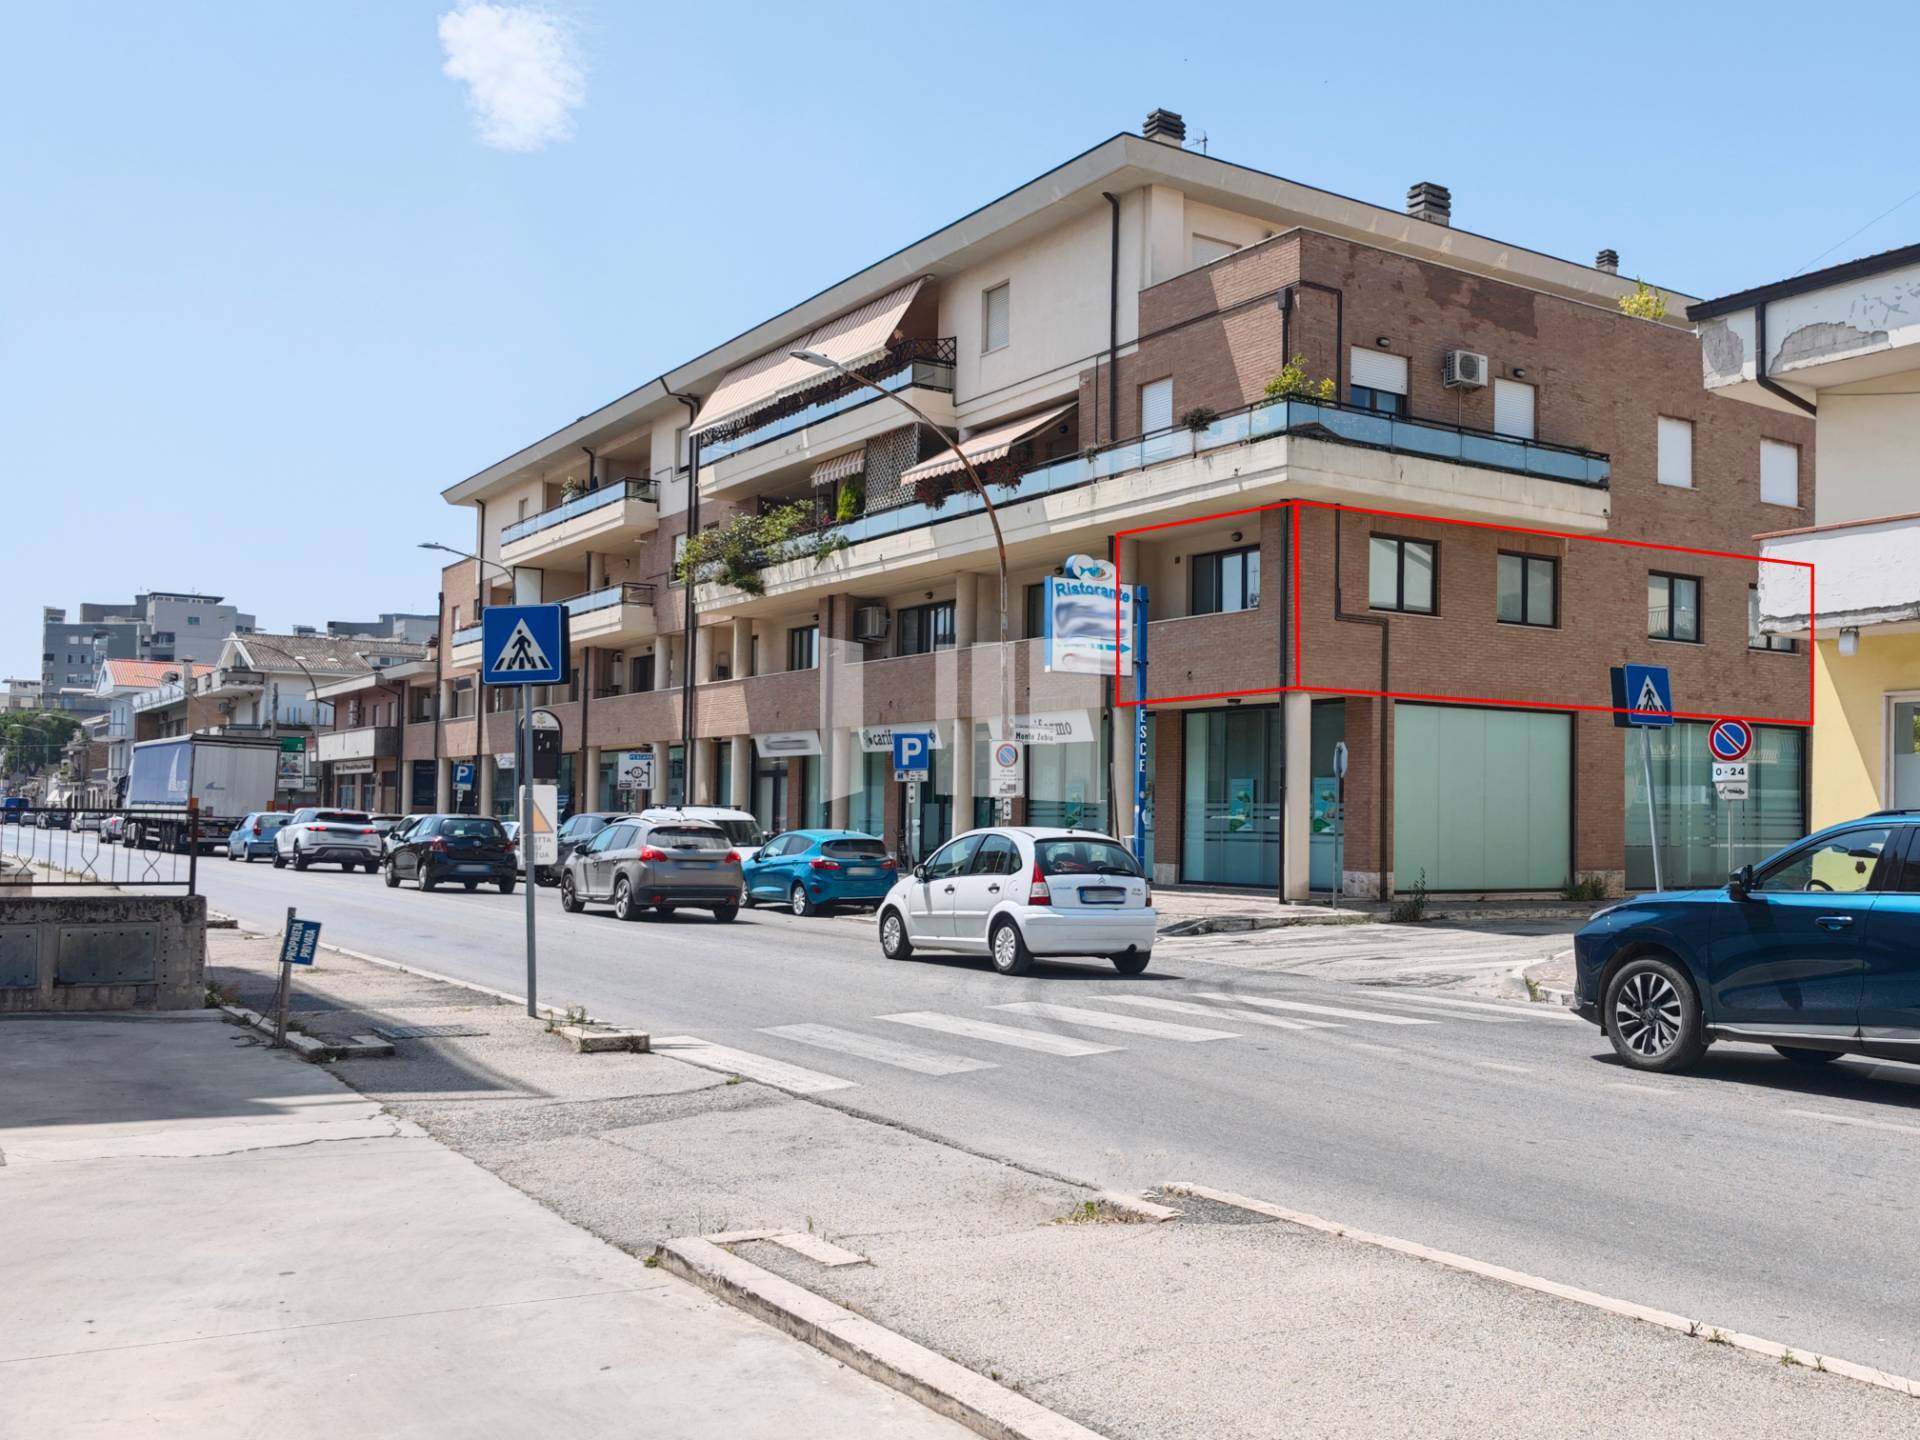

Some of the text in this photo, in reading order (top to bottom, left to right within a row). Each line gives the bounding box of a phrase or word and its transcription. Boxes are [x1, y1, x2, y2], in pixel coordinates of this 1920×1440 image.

[901, 737, 922, 766] P
[456, 766, 469, 781] P
[1730, 768, 1744, 776] 24
